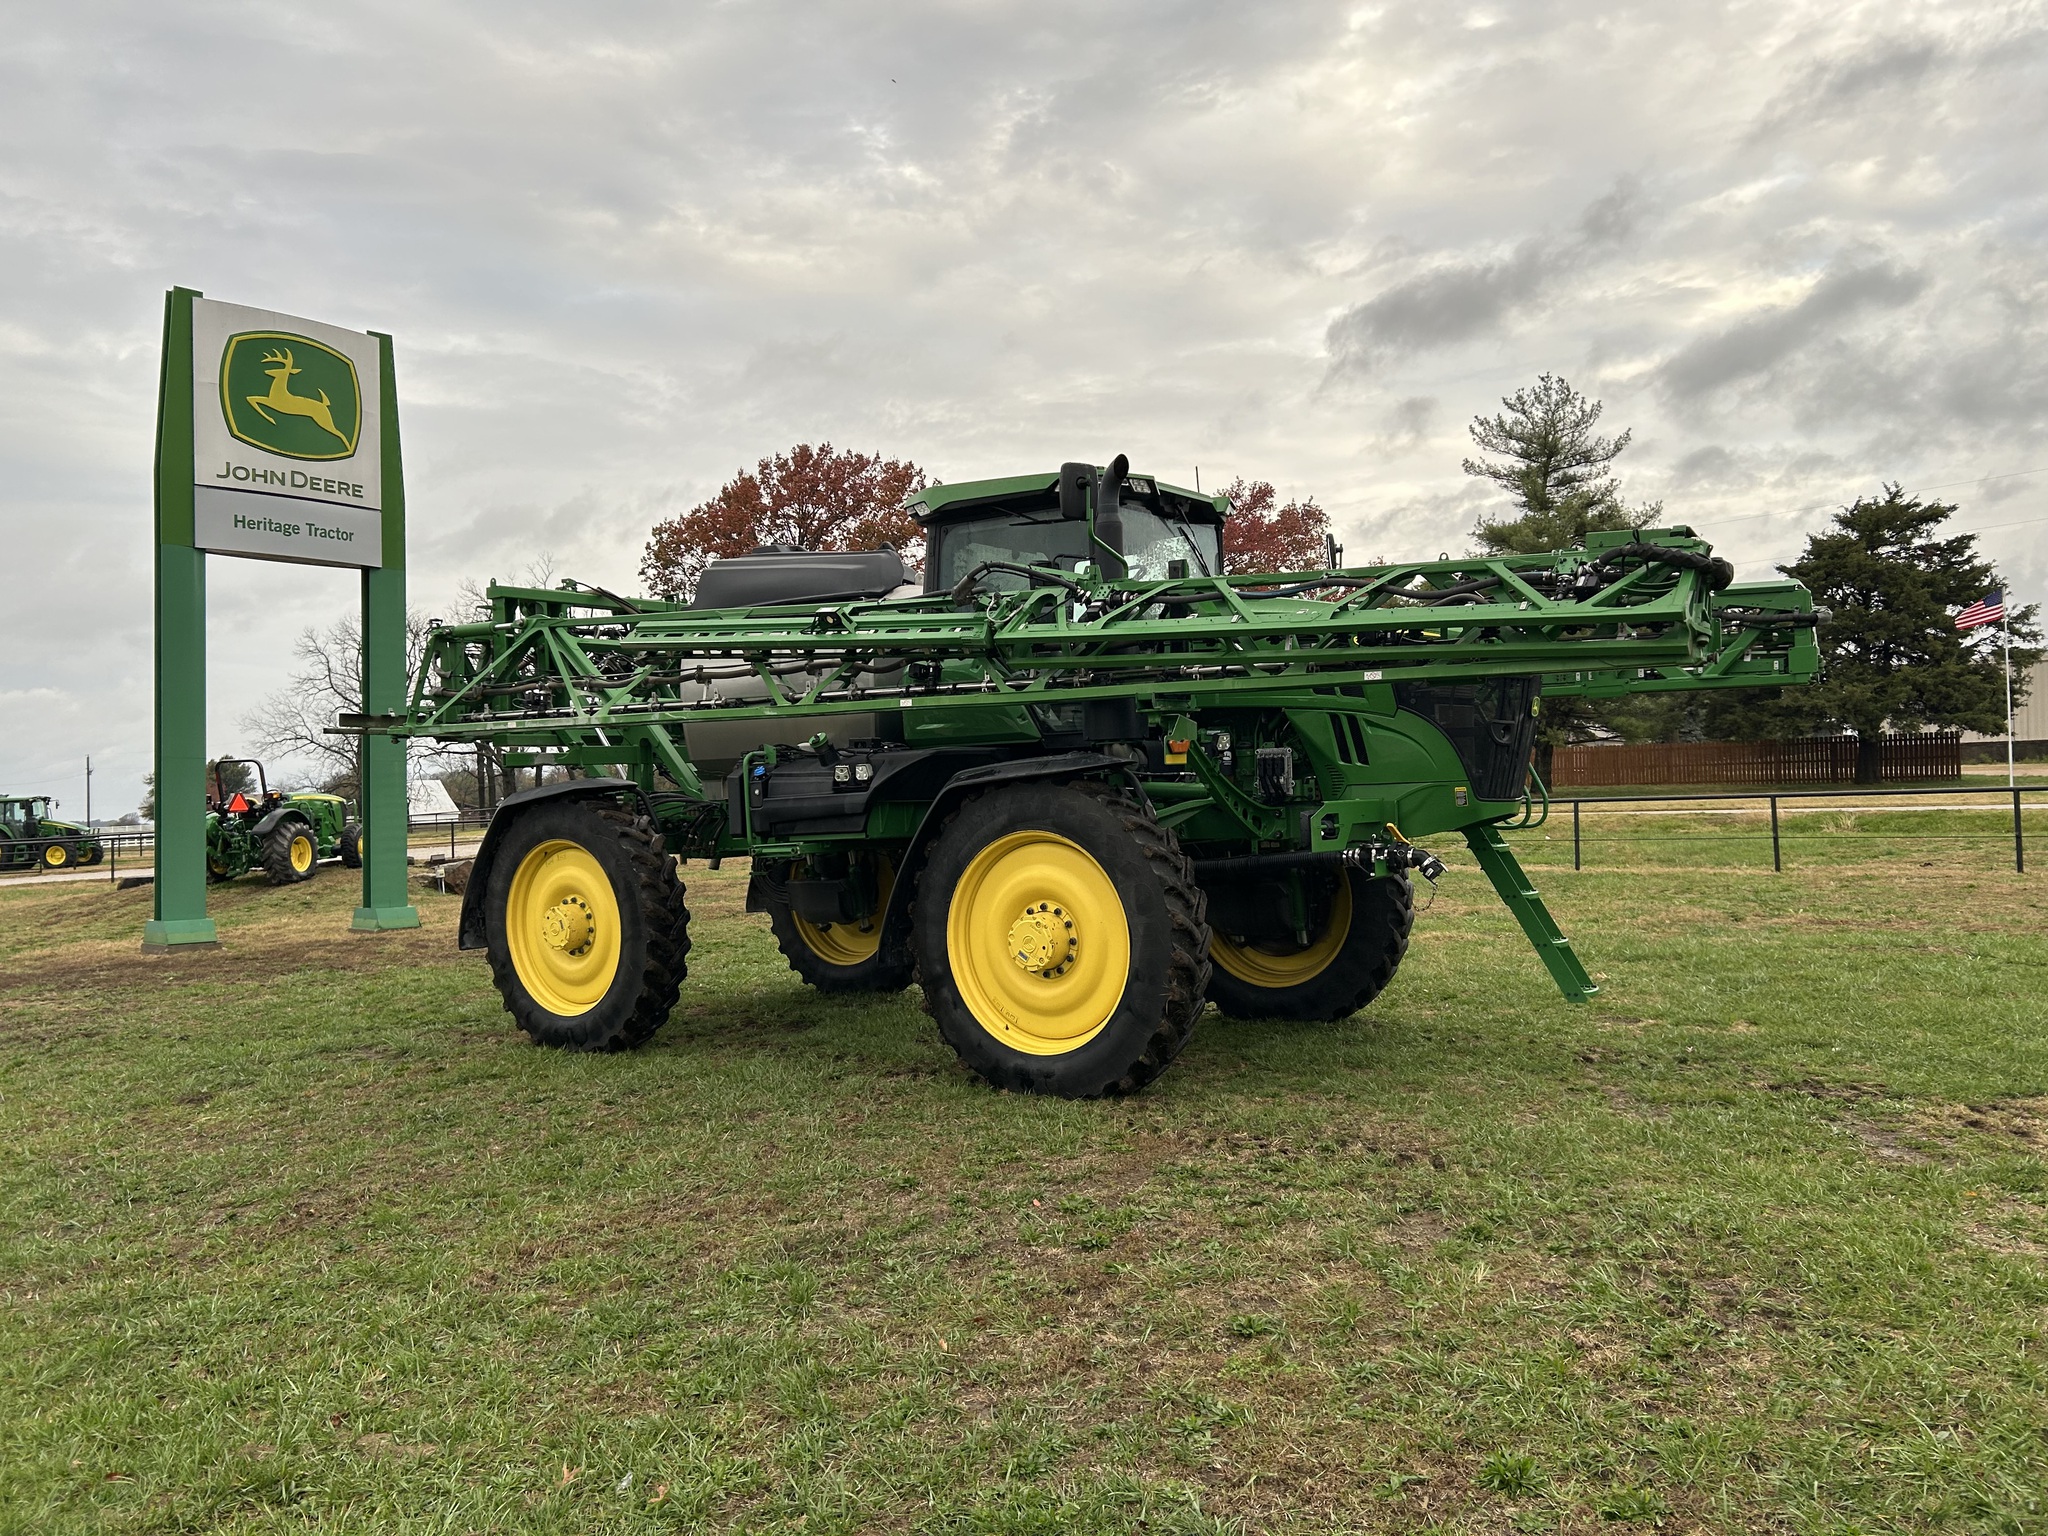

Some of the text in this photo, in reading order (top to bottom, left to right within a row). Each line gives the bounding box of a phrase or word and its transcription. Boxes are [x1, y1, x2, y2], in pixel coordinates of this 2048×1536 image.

[216, 461, 364, 499] JOHN DEERE
[233, 514, 354, 542] Heritage Tractor
